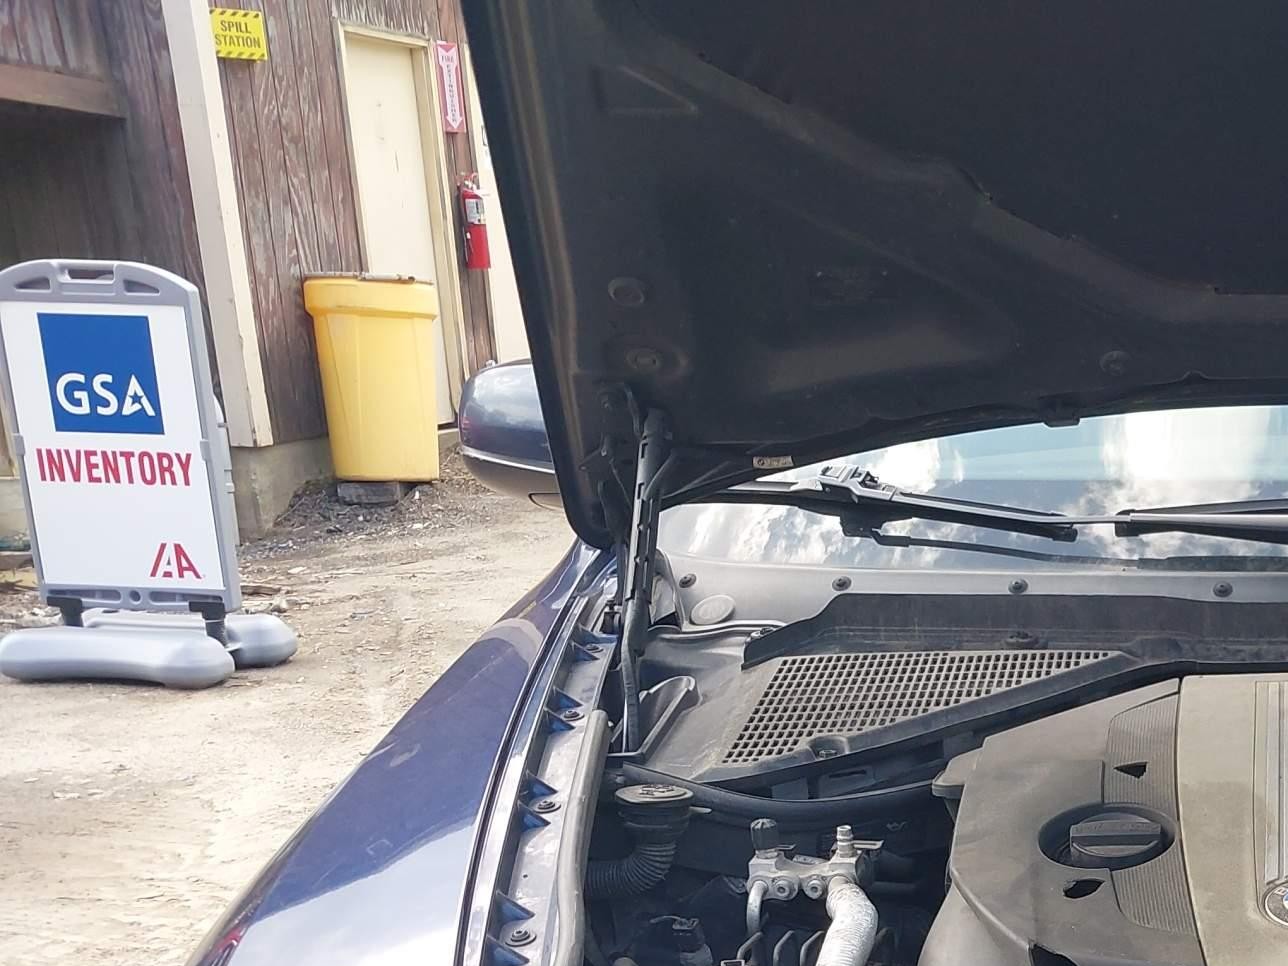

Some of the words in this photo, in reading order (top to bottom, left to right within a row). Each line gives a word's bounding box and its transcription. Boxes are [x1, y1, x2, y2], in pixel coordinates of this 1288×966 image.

[220, 20, 251, 33] SPILL
[214, 34, 261, 48] STATION
[56, 372, 156, 417] GSA
[36, 448, 192, 486] INVENTORY
